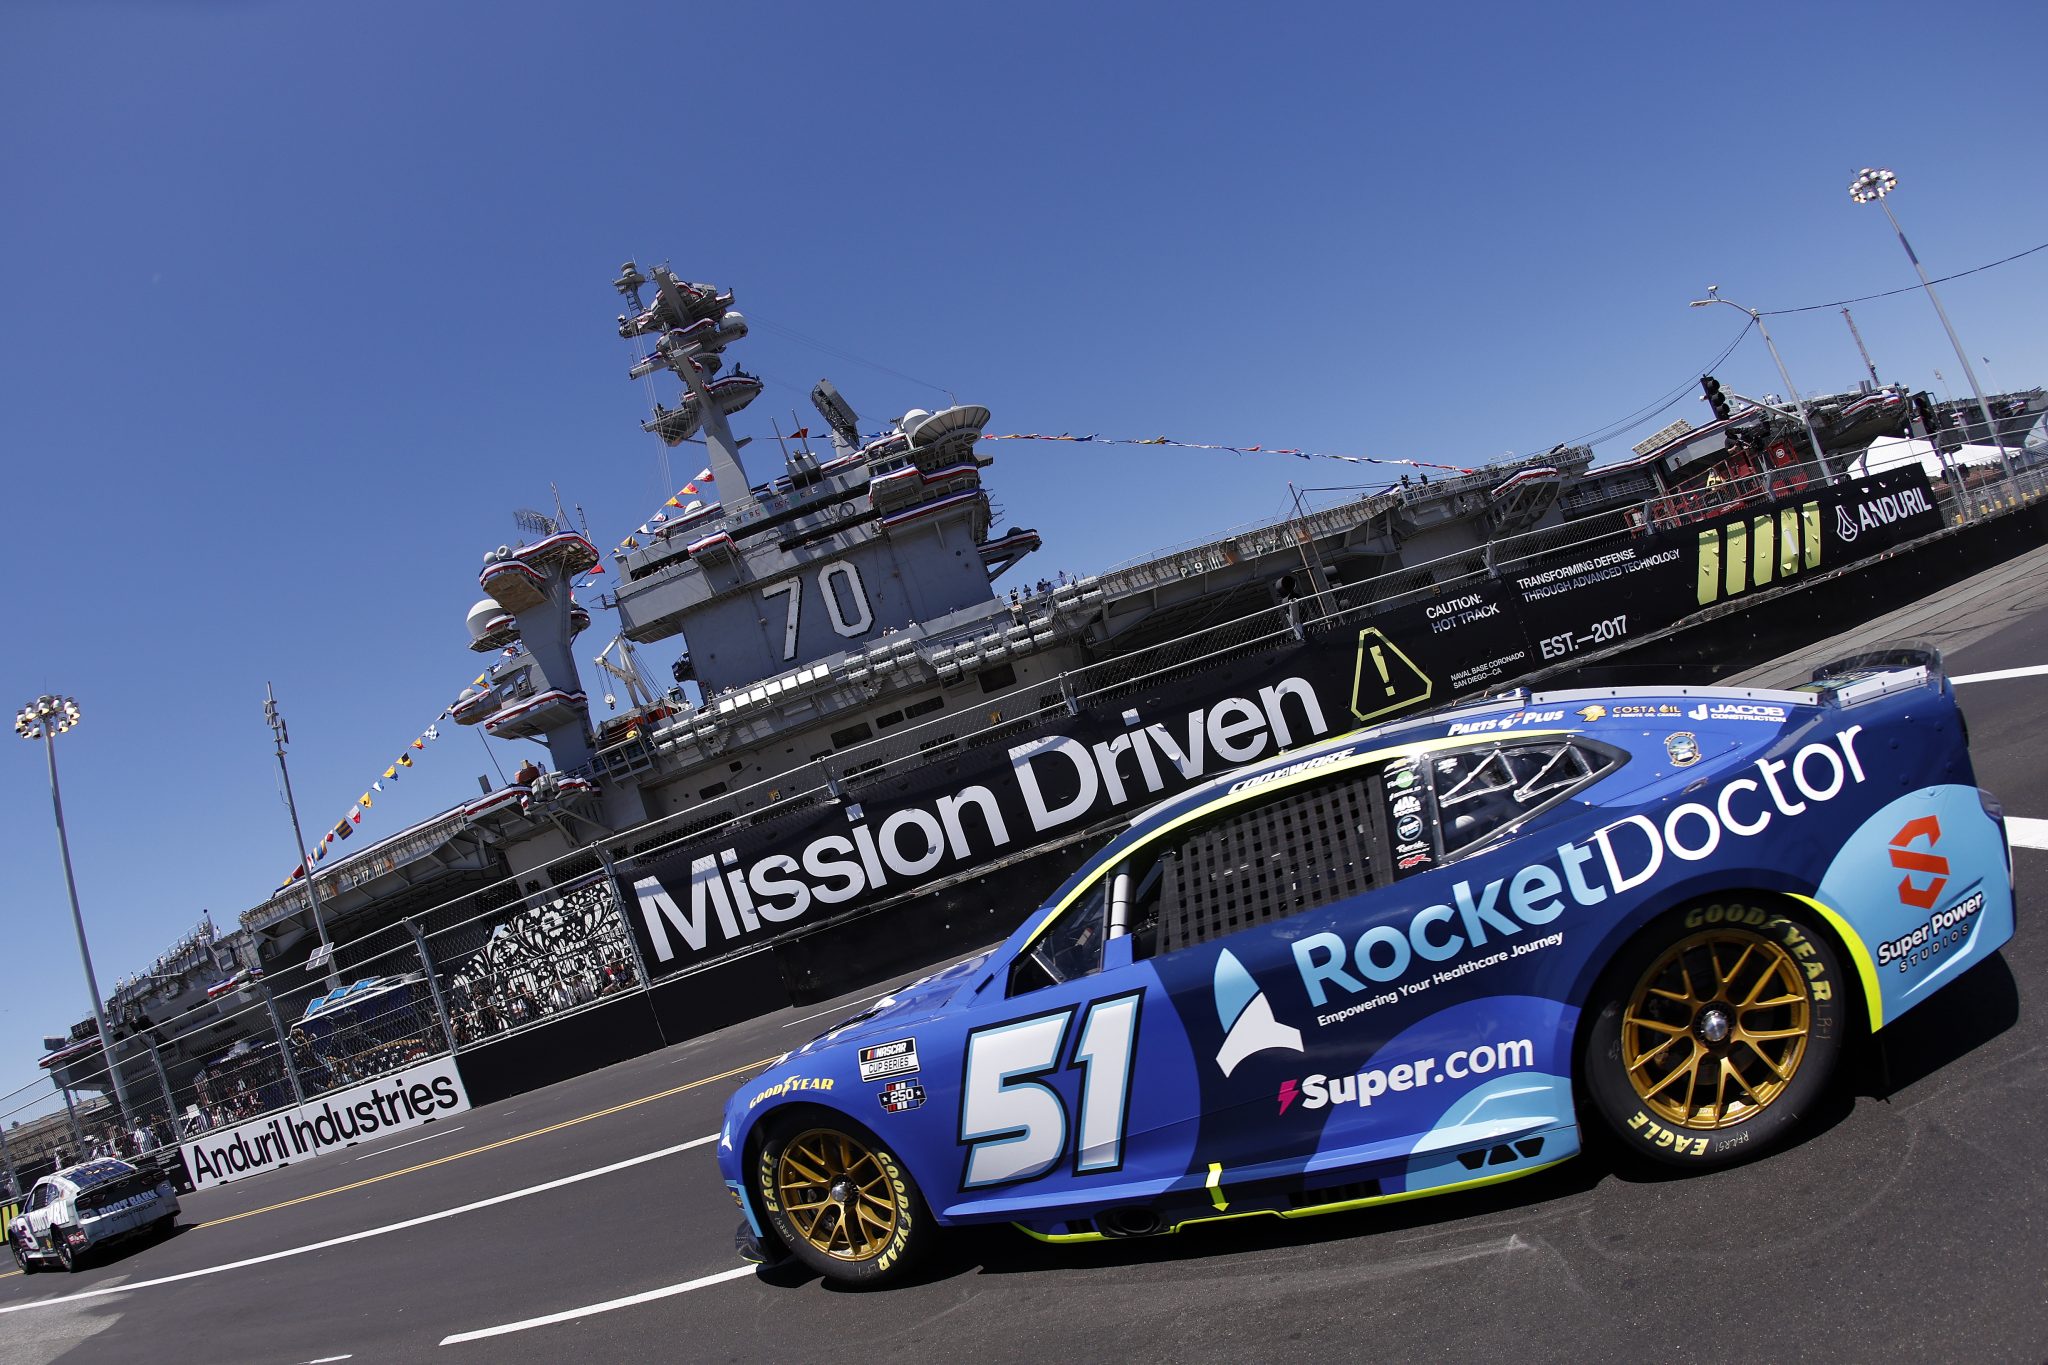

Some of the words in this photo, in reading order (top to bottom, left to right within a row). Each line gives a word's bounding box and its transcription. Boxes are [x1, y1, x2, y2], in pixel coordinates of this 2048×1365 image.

[1858, 487, 1933, 532] ANDURIL
[1516, 561, 1595, 590] TRANSFORMING
[1595, 549, 1637, 569] DEFENSE
[1522, 581, 1573, 603] THROUGH
[1573, 565, 1623, 590] ADVANCED
[1622, 549, 1681, 574] TECHNOLOGY
[762, 560, 875, 661] 70
[1426, 593, 1483, 619] CAUTION:
[1431, 616, 1459, 634] HOT
[1458, 602, 1501, 625] TRACK
[1450, 669, 1471, 682] NAVAL
[1471, 663, 1489, 675] BASE
[1488, 651, 1525, 669] CORONADO
[1453, 679, 1468, 689] SAN
[1447, 719, 1498, 737] PARTS
[1522, 710, 1565, 725] PLUS
[1613, 706, 1656, 714] COSTA
[1659, 704, 1681, 713] OIL
[1710, 704, 1785, 717] JACOB
[1711, 713, 1787, 723] CONSTRUCTION
[633, 785, 1010, 964] Mission
[1008, 677, 1329, 828] Driven
[1292, 725, 1866, 1008] RocketDoctor
[1877, 924, 1930, 966] Super
[1931, 891, 1984, 935] Power
[1900, 924, 1970, 973] STUDIOS
[1685, 903, 1833, 1002] GOODYEAR
[1317, 990, 1399, 1027] Empowering
[1399, 979, 1431, 998] Your
[1432, 951, 1508, 986] Healthcare
[1510, 932, 1564, 958] Journey
[868, 1060, 883, 1074] CUP
[883, 1057, 909, 1071] SERIES
[875, 1042, 908, 1059] NASCAR
[749, 1074, 835, 1110] GOODYEAR
[957, 986, 1148, 1194] 51
[1301, 1039, 1535, 1110] Super.com
[890, 1088, 914, 1103] 250
[194, 1119, 291, 1184] Anduril
[285, 1075, 459, 1155] Industries
[1627, 1110, 1709, 1156] EAGLE
[98, 1199, 129, 1215] BOOT
[128, 1189, 159, 1206] BARN
[763, 1151, 780, 1212] EAGLE
[112, 1200, 158, 1222] CHEVROLET
[878, 1152, 913, 1271] GOODYEAR
[16, 1217, 40, 1250] 3
